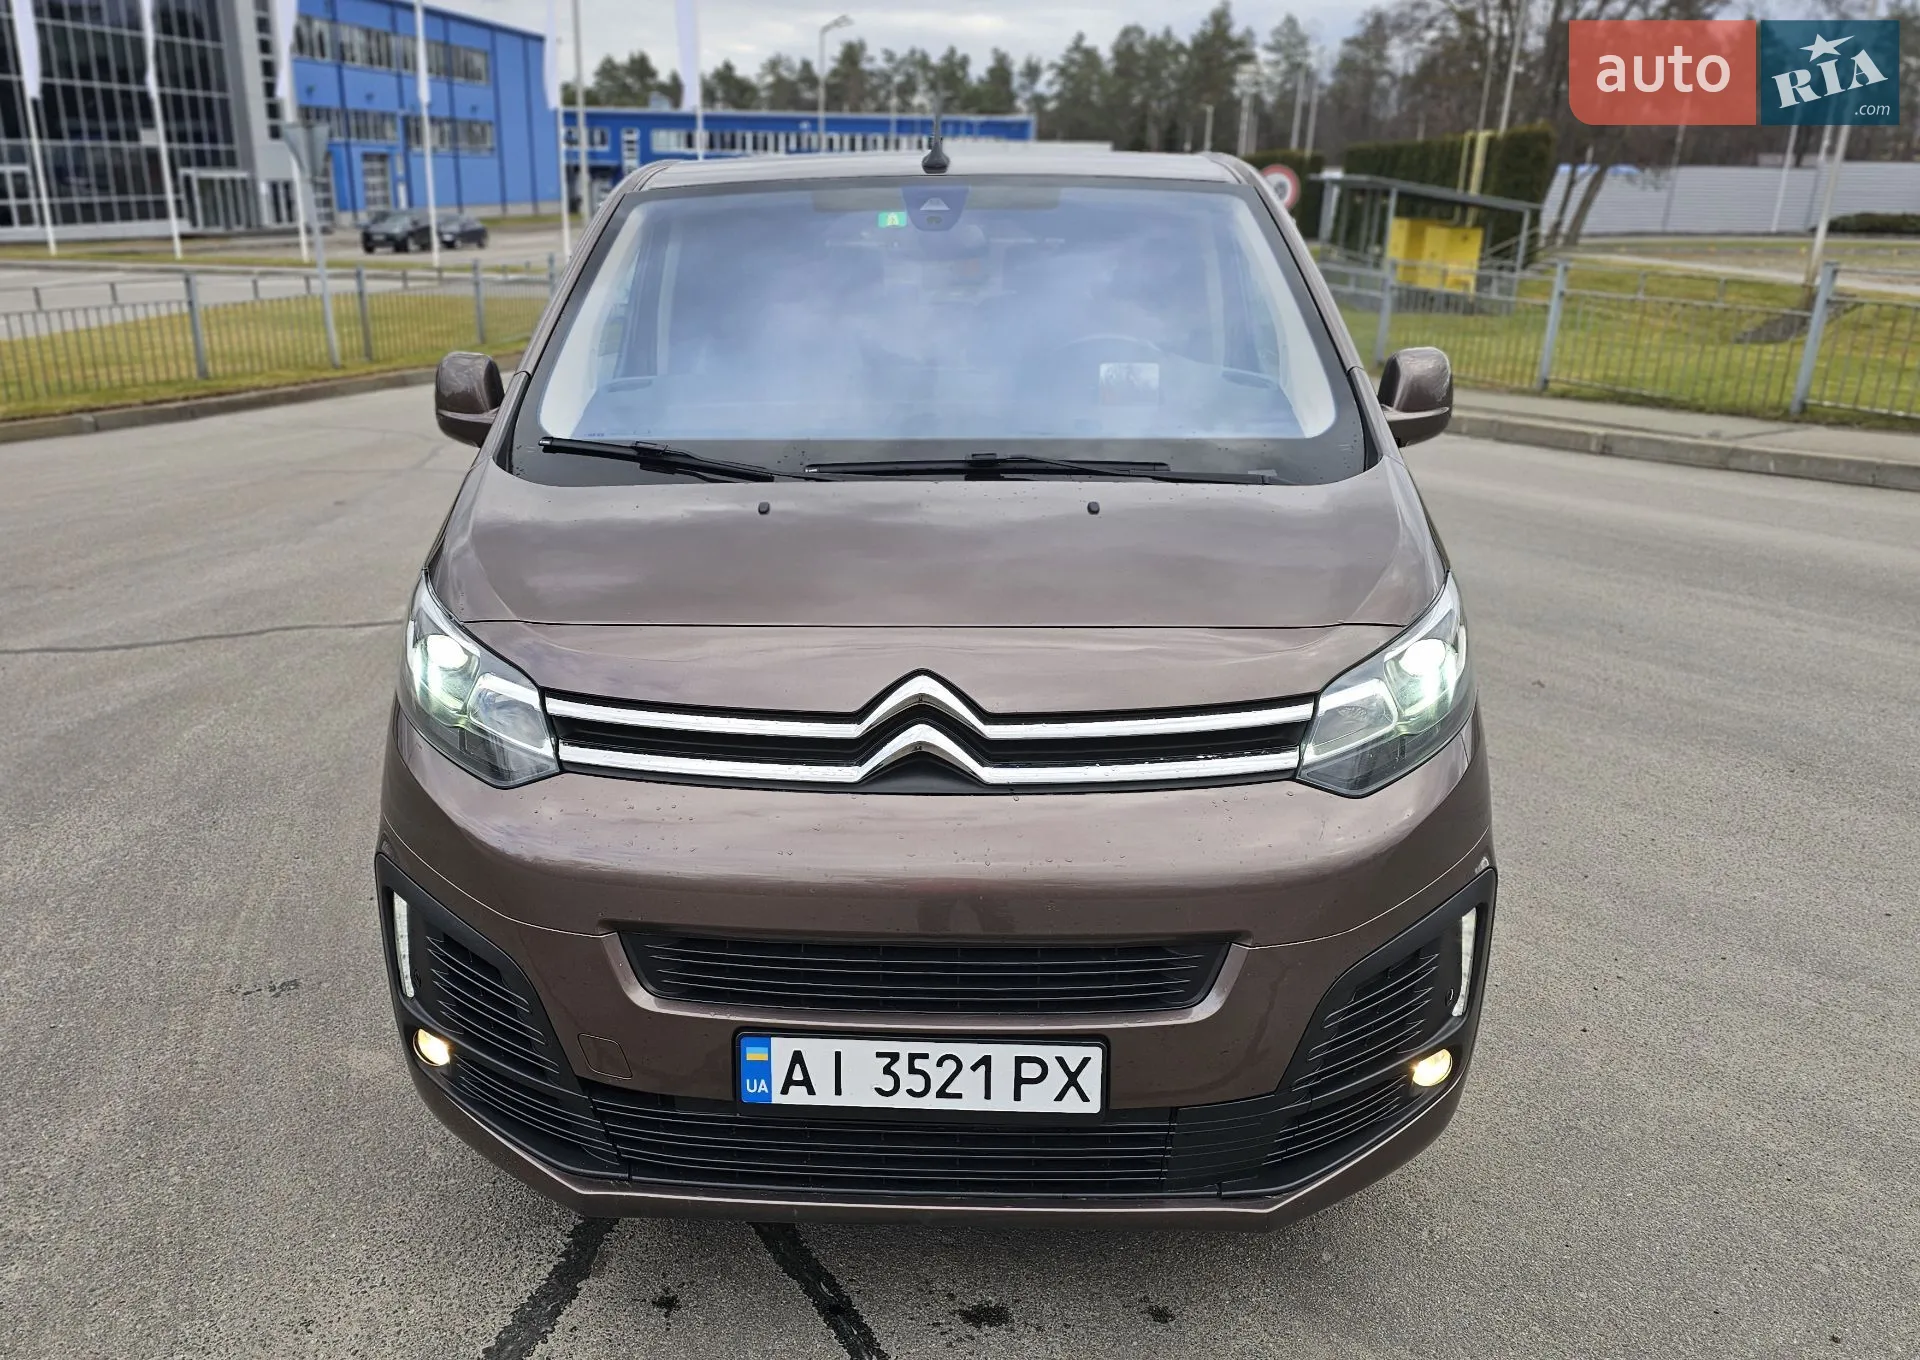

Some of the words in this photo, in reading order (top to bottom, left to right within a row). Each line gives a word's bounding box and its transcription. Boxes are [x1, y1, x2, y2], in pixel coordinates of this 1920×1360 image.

[746, 1078, 769, 1094] UA
[874, 1051, 993, 1100] 3521
[1013, 1055, 1092, 1103] PX
